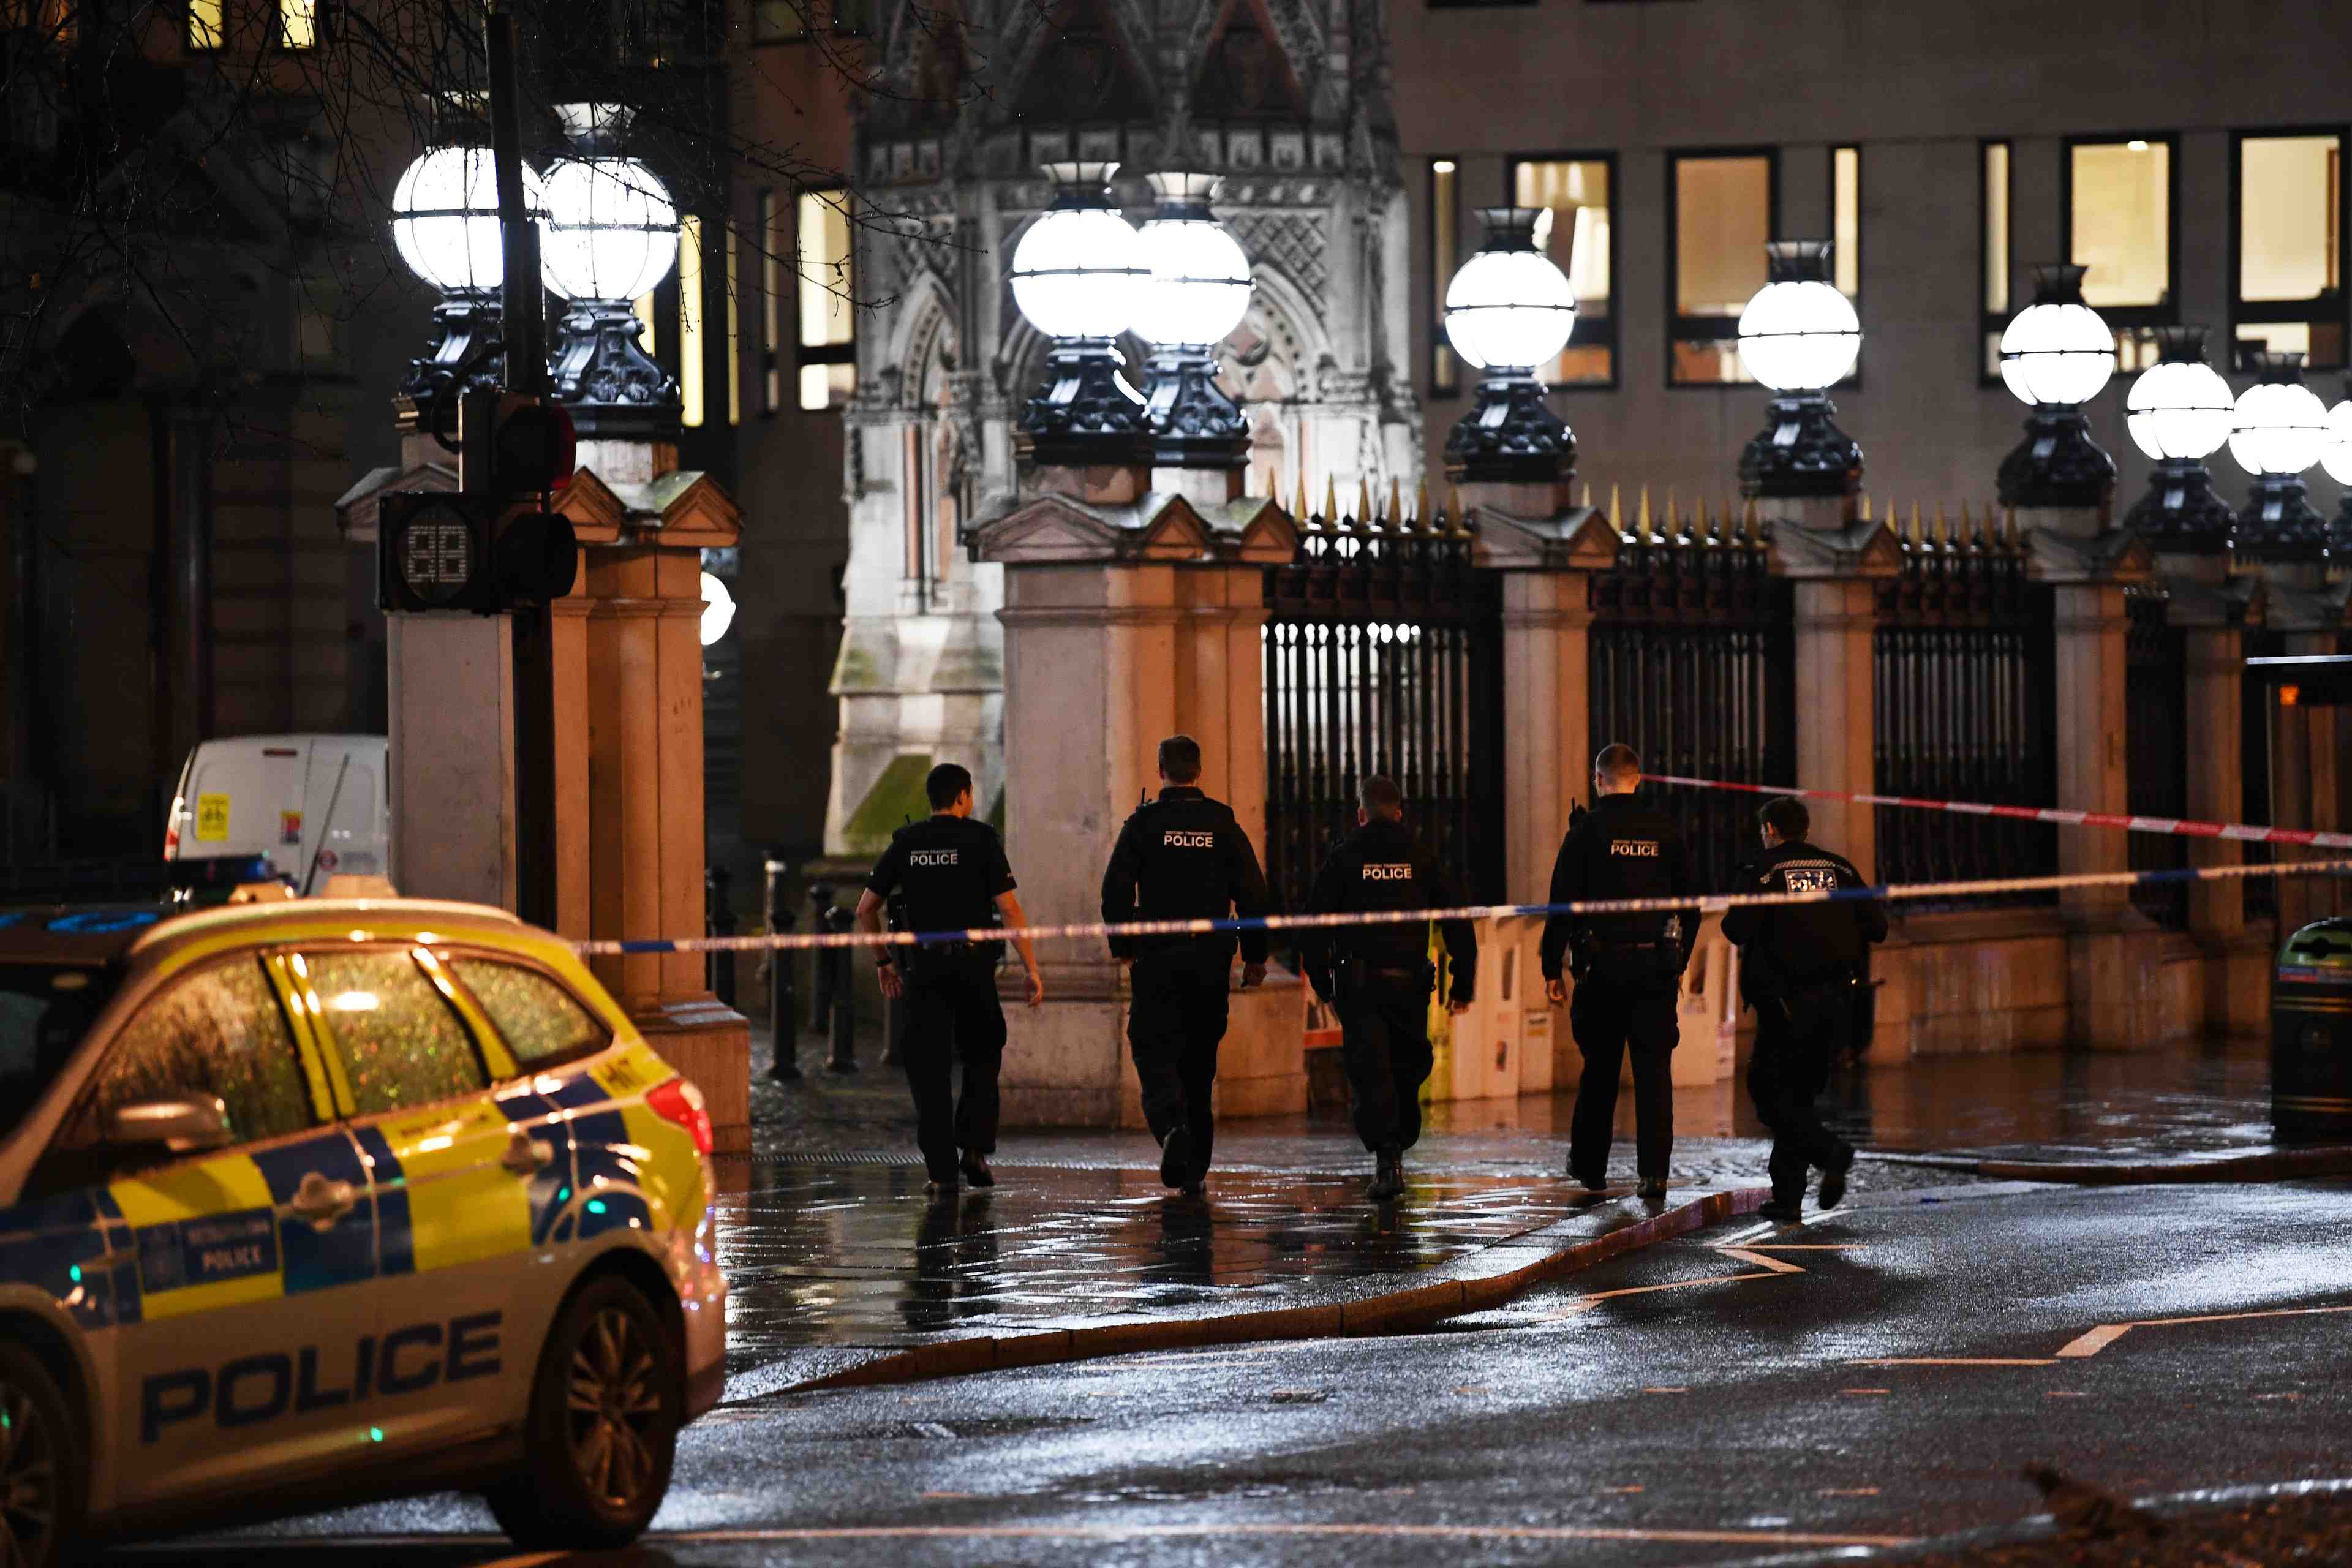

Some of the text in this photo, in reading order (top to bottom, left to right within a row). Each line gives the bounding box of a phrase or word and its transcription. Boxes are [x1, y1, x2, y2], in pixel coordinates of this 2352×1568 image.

[1164, 835, 1213, 848] POLICE
[1611, 844, 1658, 856] POLICE
[910, 853, 959, 867] POLICE
[1362, 867, 1412, 880] POLICE
[140, 1311, 502, 1445] POLICE
